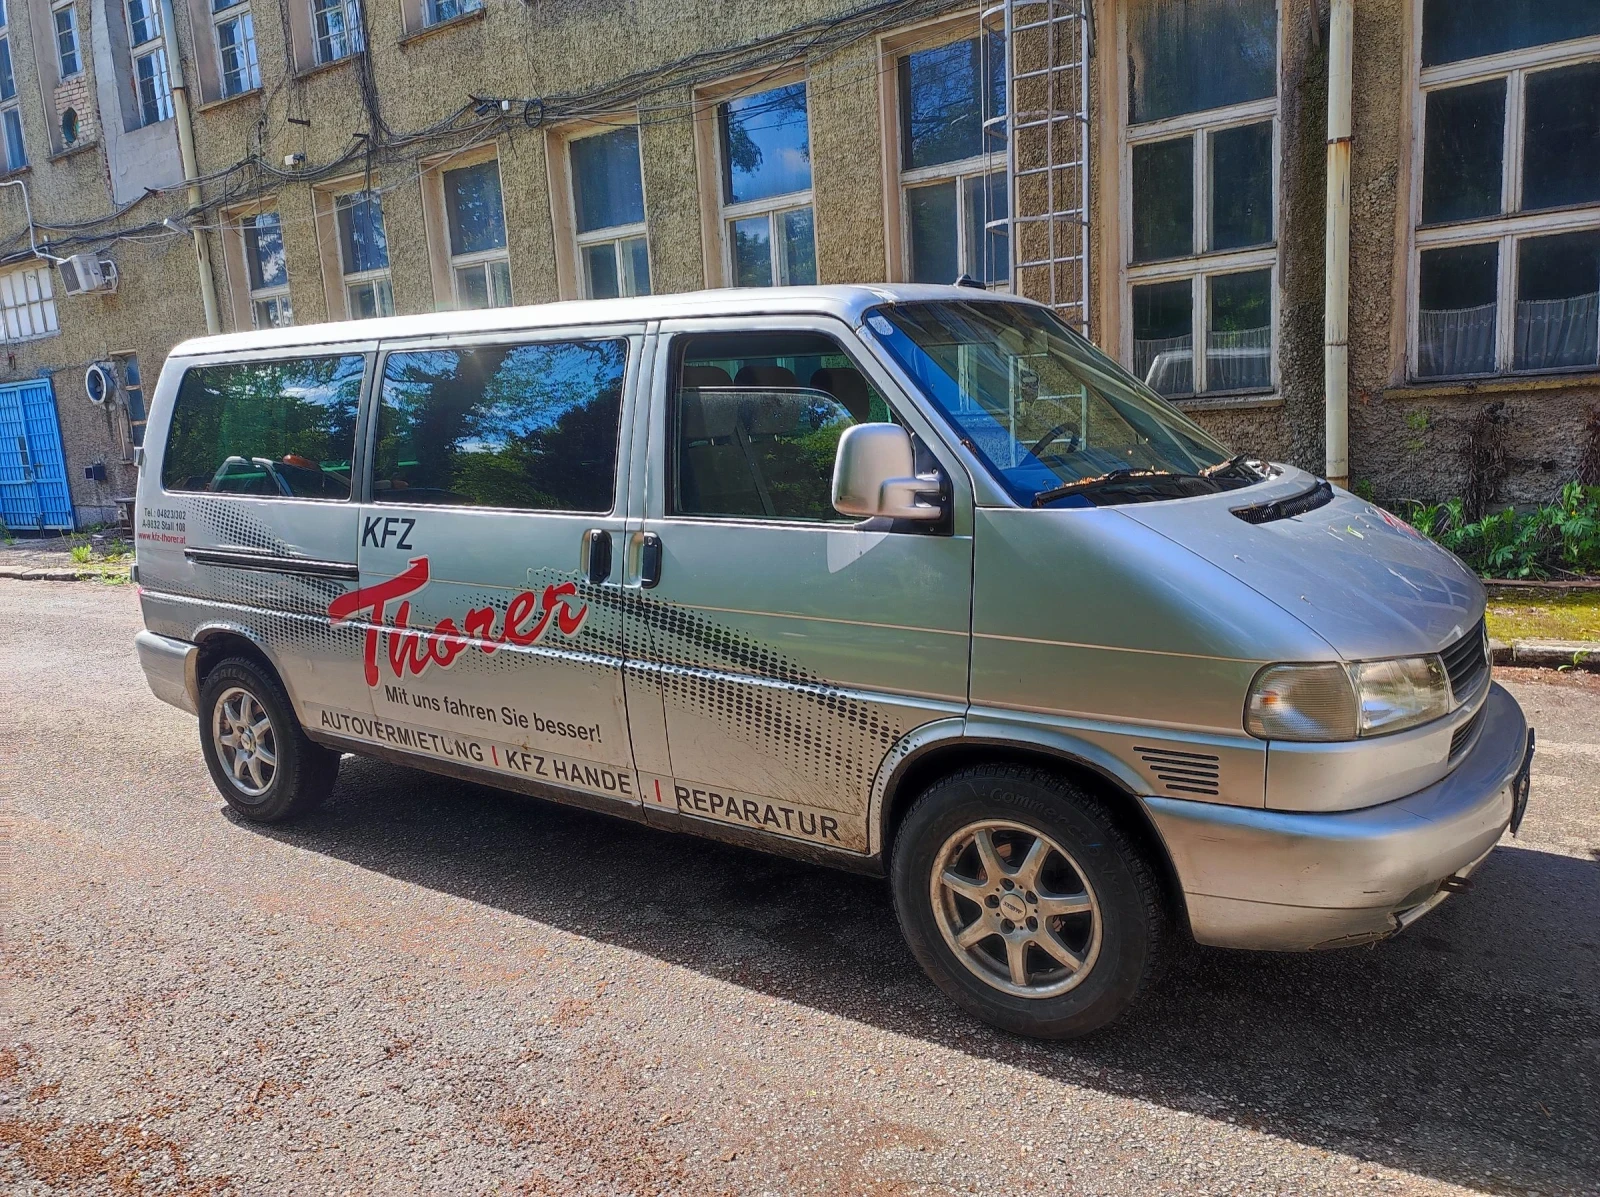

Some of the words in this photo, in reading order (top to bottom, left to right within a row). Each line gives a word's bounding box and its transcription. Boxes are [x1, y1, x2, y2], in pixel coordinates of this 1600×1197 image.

[161, 520, 174, 532] Stall
[361, 516, 416, 550] KFZ
[326, 556, 588, 687] Thorer
[384, 684, 410, 706] Mit
[412, 693, 441, 712] uns
[443, 696, 498, 723] fahren
[500, 706, 529, 729] Sie
[533, 712, 603, 744] besser!
[321, 709, 485, 763] AUTOVERMIETUNG
[505, 749, 549, 777] KFZ
[553, 759, 633, 795] HANDE
[674, 785, 841, 841] REPARATUR
